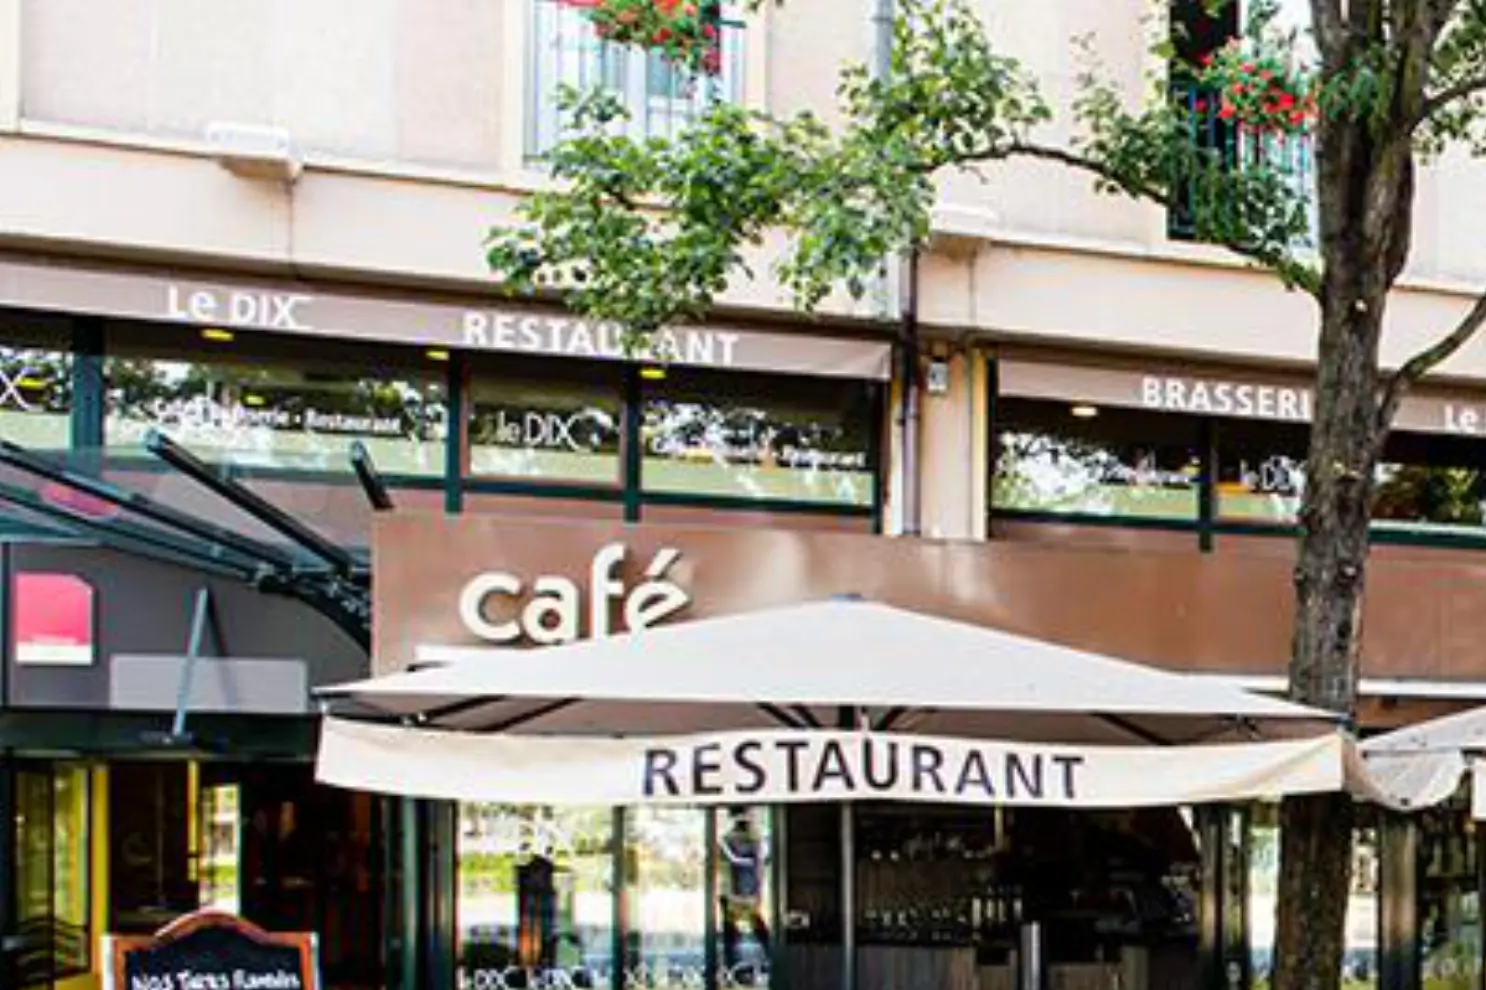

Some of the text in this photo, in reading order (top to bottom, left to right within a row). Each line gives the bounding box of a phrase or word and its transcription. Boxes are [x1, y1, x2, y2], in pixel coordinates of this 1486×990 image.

[168, 285, 313, 331] Le DIX
[462, 310, 740, 366] RESTAUANT
[1142, 376, 1312, 421] BRASSERI
[1443, 404, 1477, 434] Le
[458, 542, 690, 645] café
[641, 737, 1086, 800] RESTAURANT
